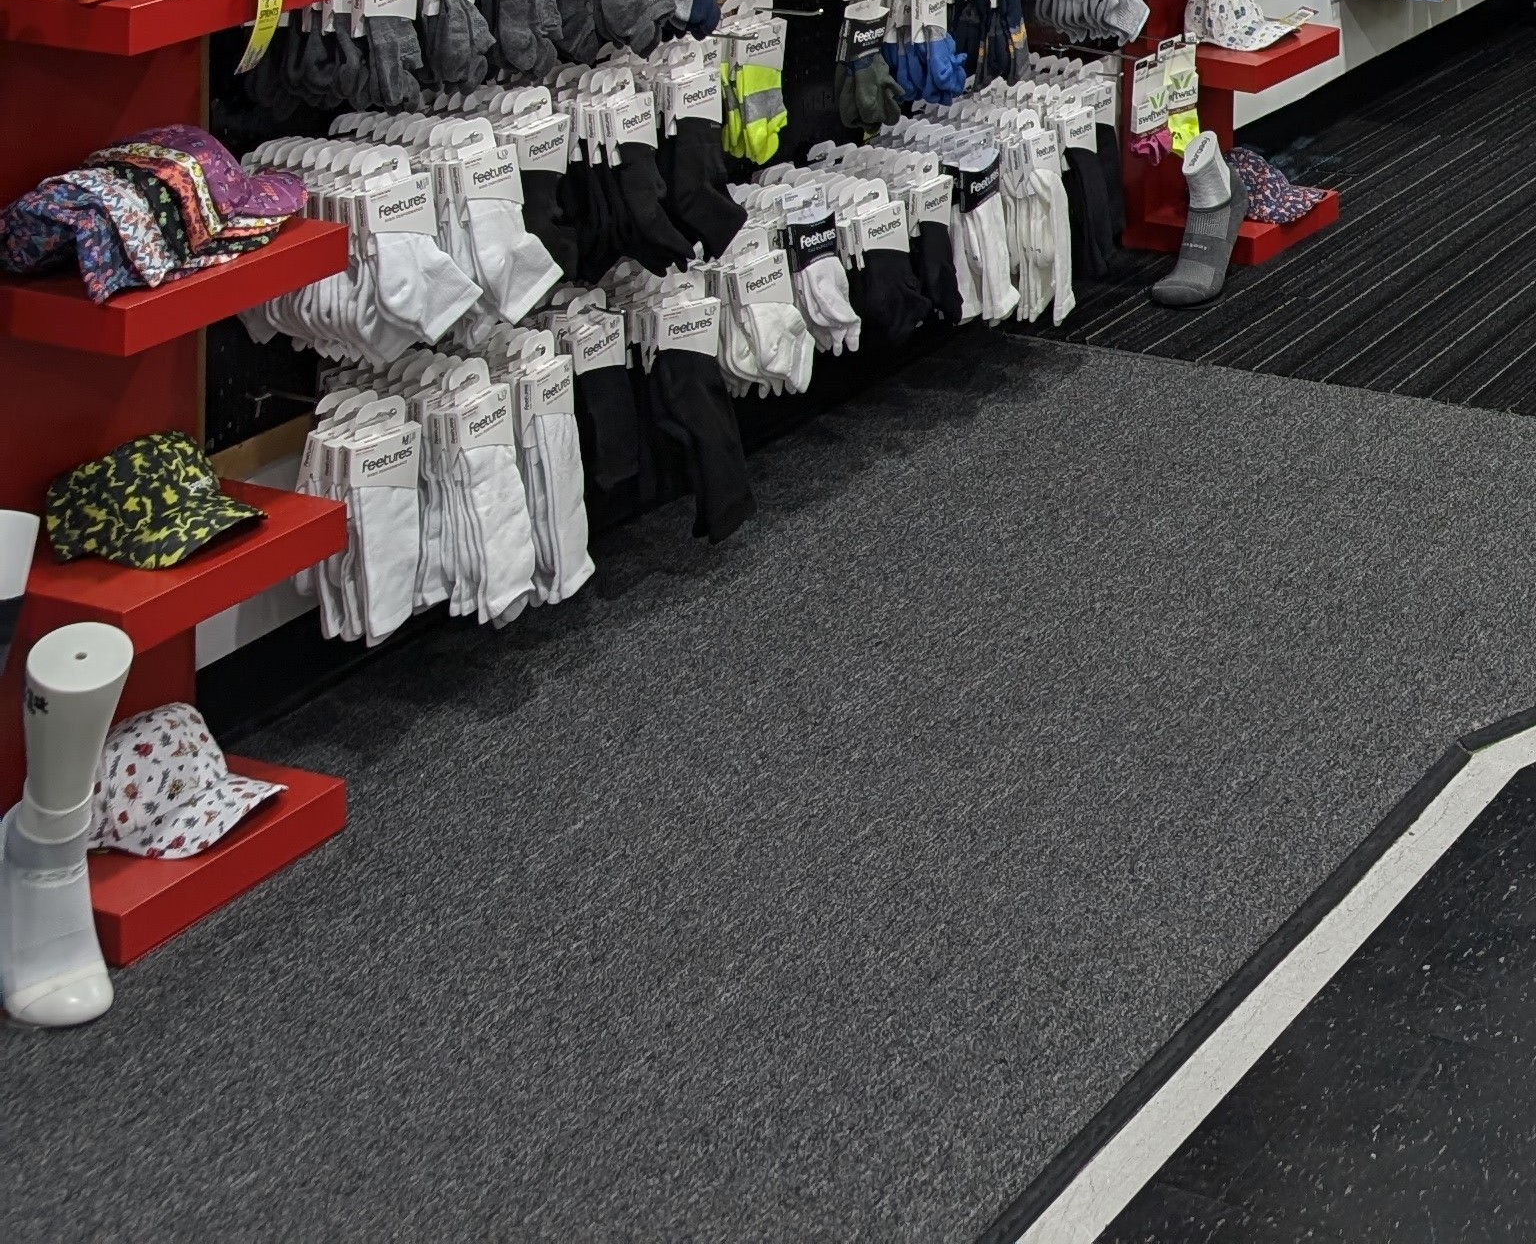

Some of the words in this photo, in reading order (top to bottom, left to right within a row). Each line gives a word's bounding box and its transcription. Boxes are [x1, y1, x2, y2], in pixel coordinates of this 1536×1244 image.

[745, 36, 781, 54] feetures
[854, 26, 886, 43] feetures
[682, 85, 718, 104] feetures
[621, 110, 652, 130] feetures
[528, 134, 565, 154] feetures
[472, 162, 514, 185] feetures
[970, 169, 1000, 195] feetures
[378, 192, 427, 219] feetures
[800, 227, 836, 250] feetures
[867, 218, 902, 239] feetures
[745, 267, 784, 294] feetures
[668, 317, 713, 336] feetures
[583, 328, 620, 357] feetures
[542, 376, 571, 402] feetures
[468, 406, 508, 436] feetures
[361, 446, 413, 474] feetures
